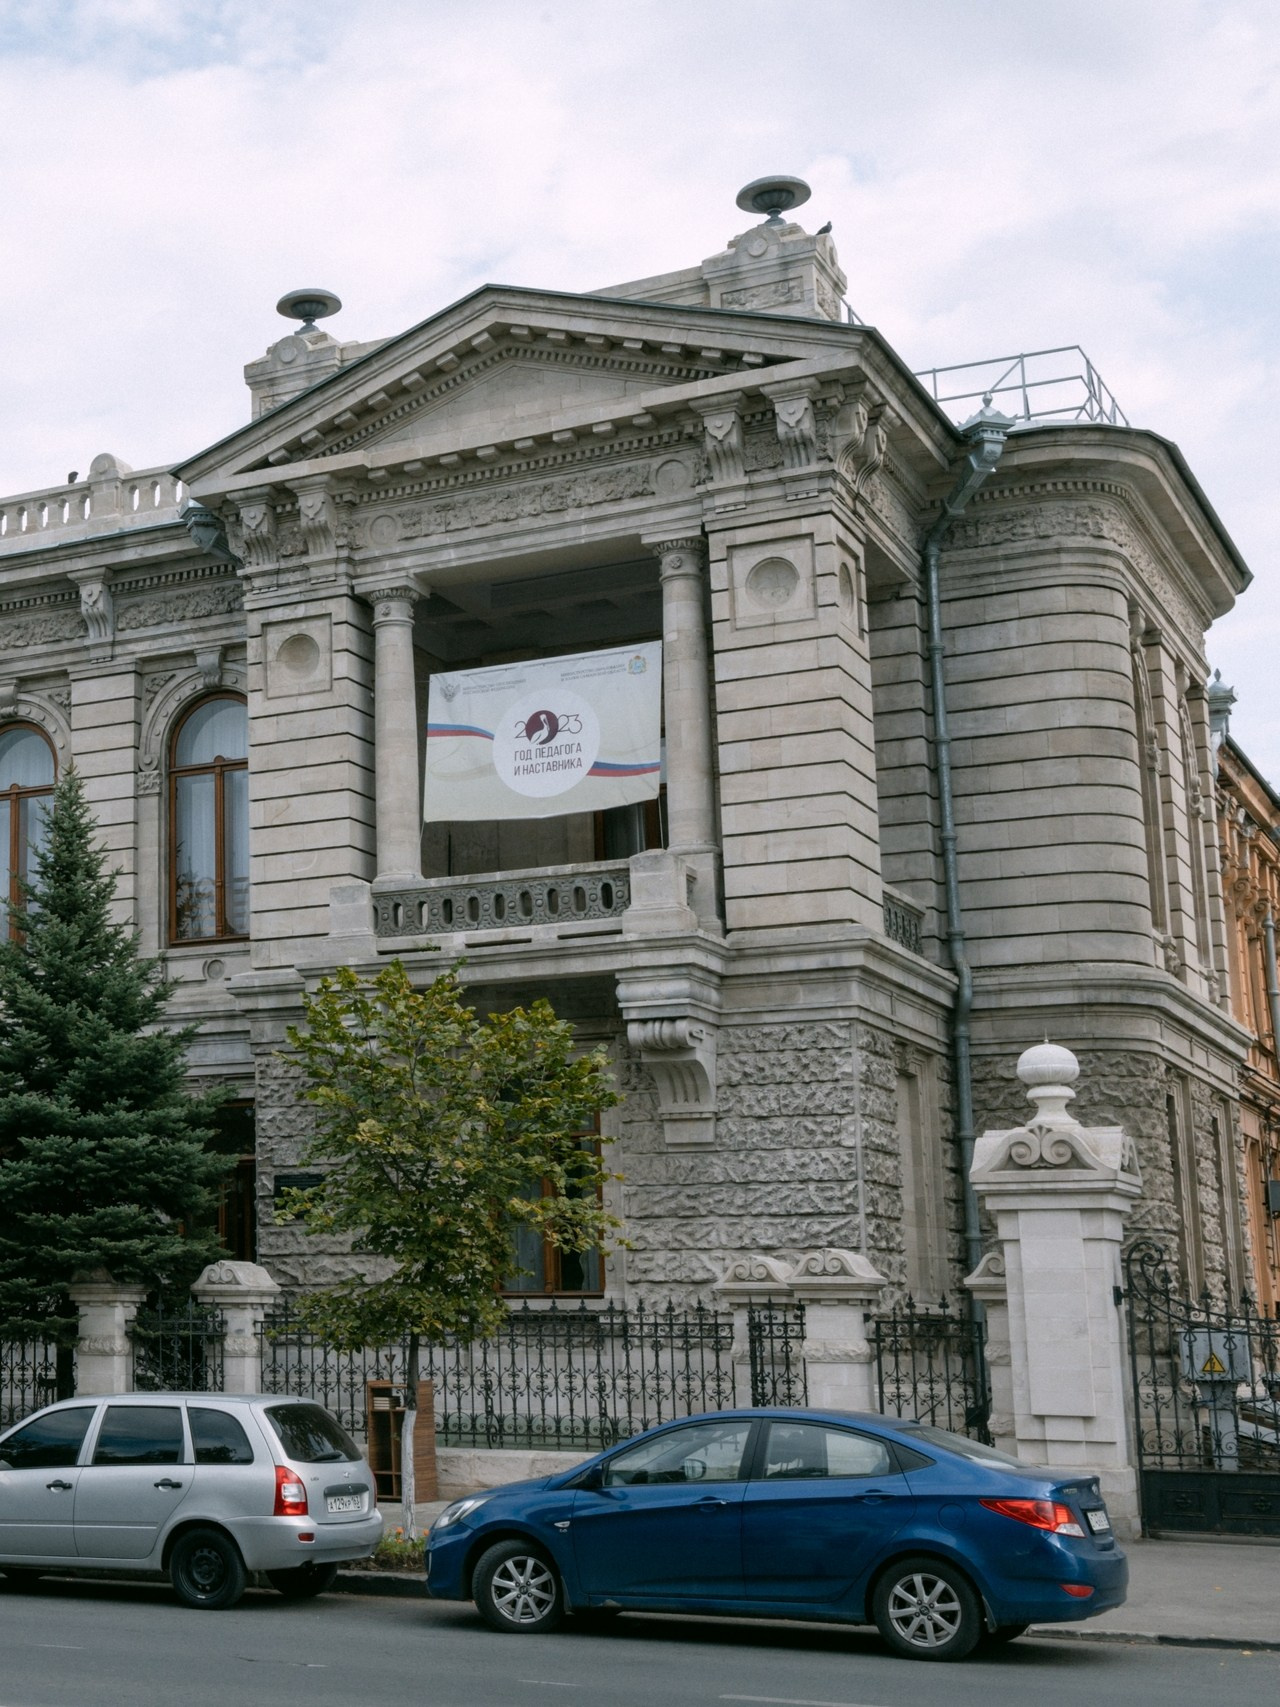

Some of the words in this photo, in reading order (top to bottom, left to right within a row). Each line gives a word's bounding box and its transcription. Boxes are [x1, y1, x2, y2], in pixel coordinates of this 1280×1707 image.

[514, 749, 533, 761] ГОД
[535, 742, 582, 759] ПЕДАГОГА
[514, 765, 521, 776] И
[522, 757, 583, 776] НАСТАВНИКА
